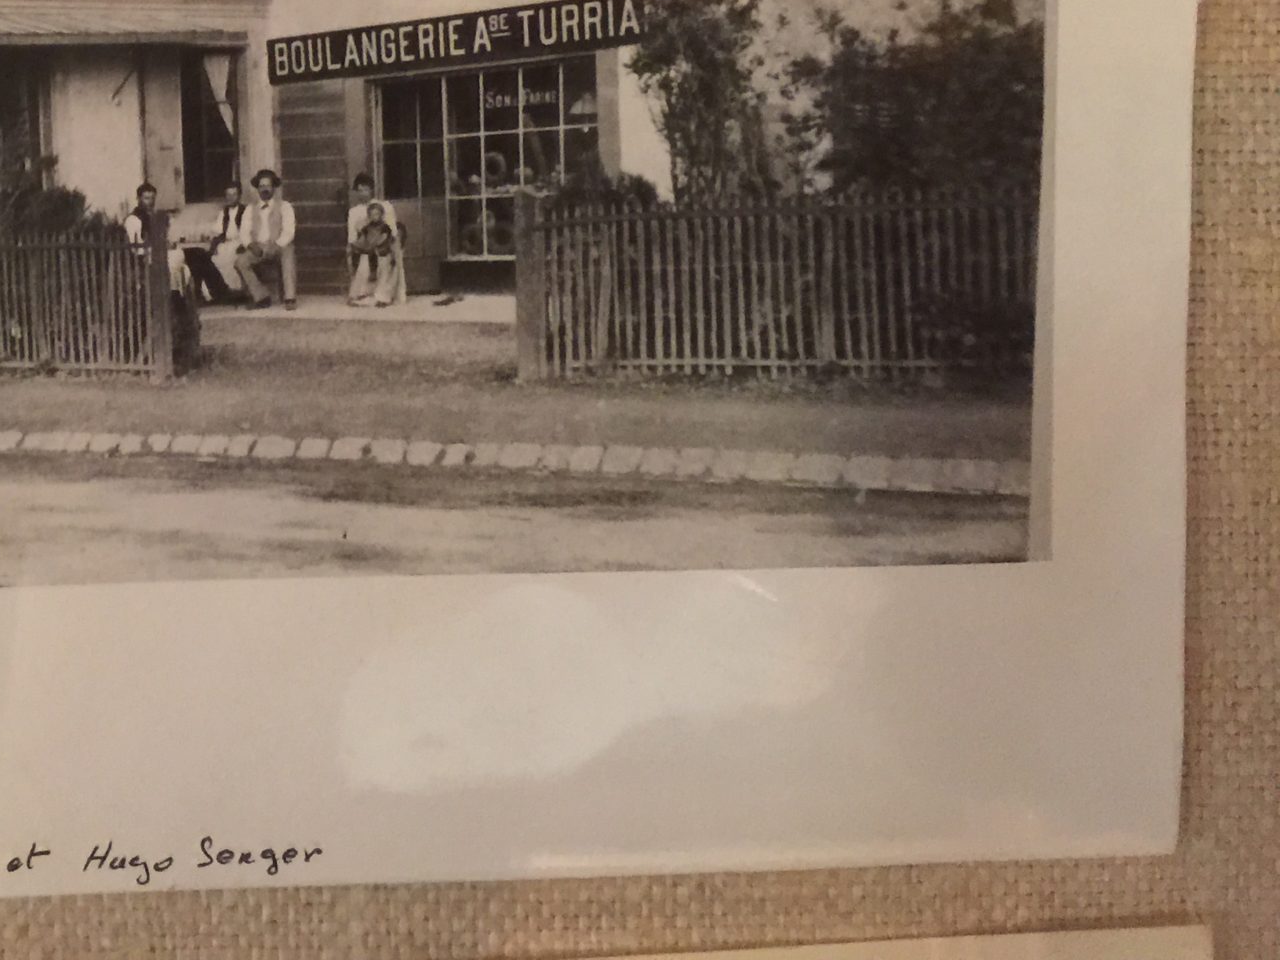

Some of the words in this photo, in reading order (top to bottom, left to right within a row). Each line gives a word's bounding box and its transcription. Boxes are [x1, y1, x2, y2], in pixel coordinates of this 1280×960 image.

[274, 18, 467, 77] BOULANGERIE
[7, 843, 52, 873] et
[82, 843, 174, 887] Hugo
